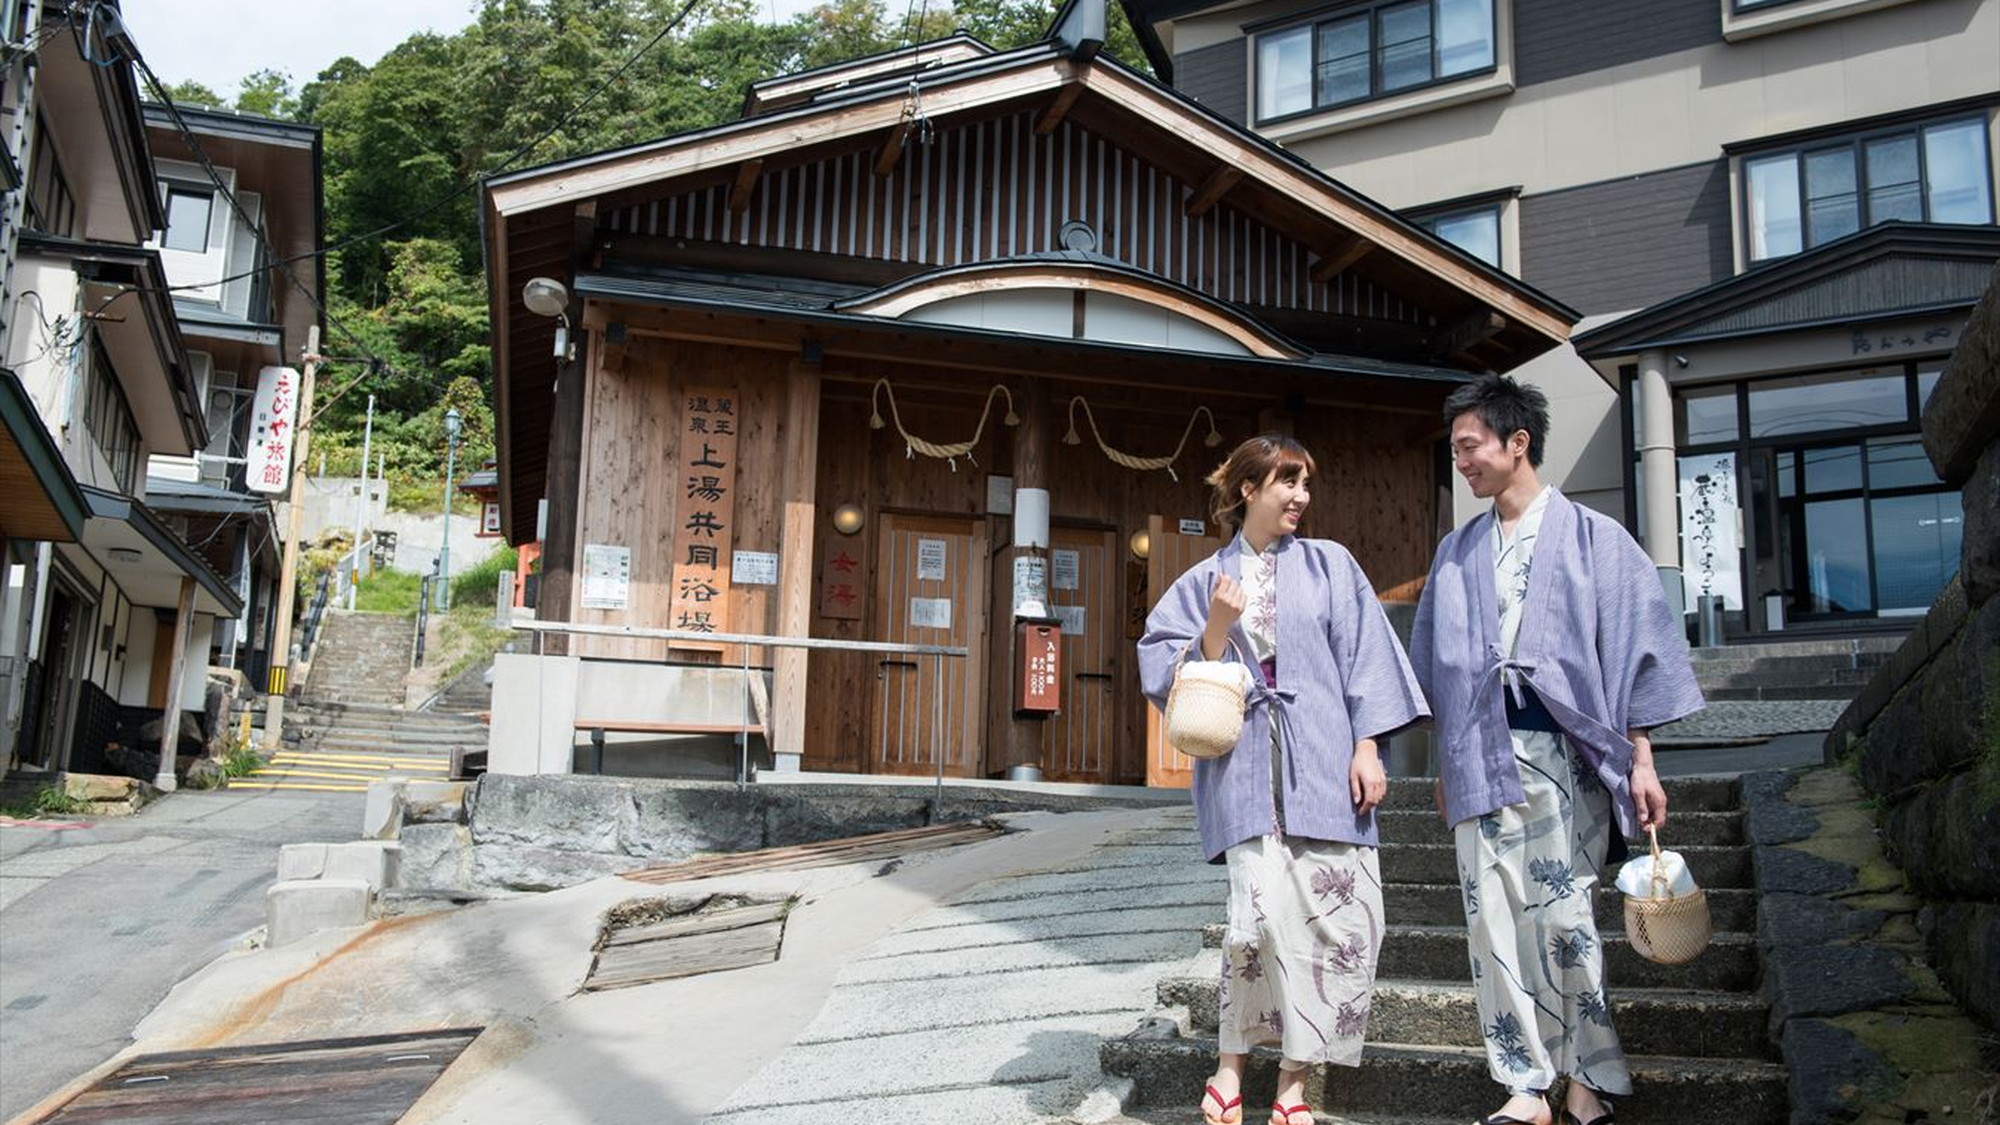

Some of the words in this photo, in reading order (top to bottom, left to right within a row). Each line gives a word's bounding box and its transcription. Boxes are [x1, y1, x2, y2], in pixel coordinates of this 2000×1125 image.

[688, 397, 712, 434] 温泉
[677, 443, 727, 633] 上湯共同浴場
[829, 550, 858, 607] 女湯
